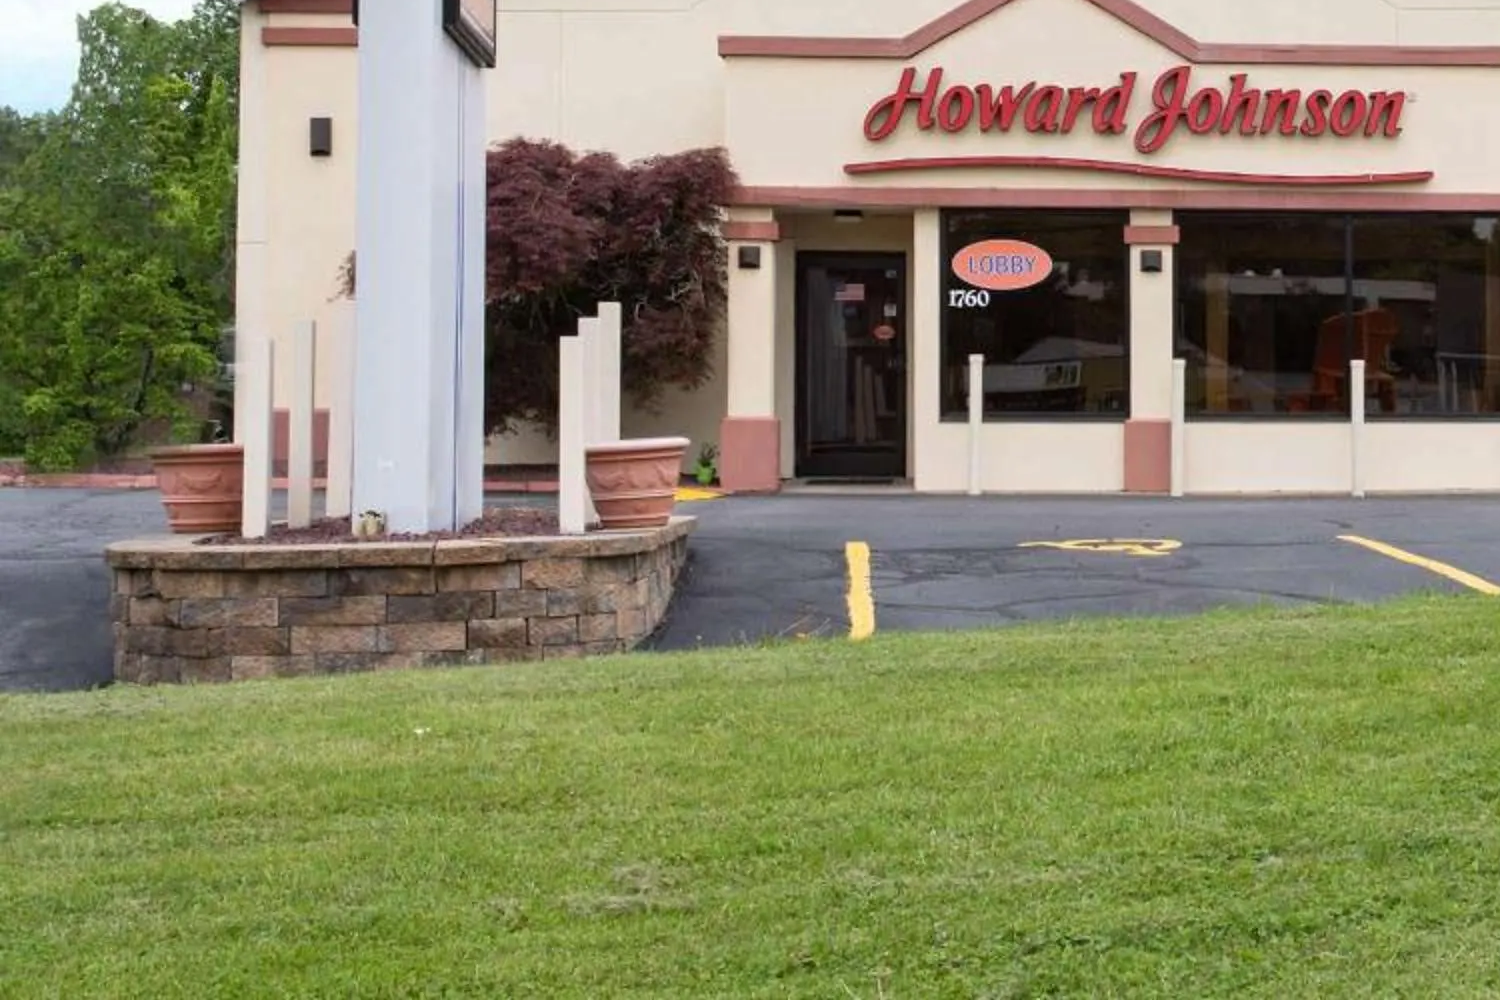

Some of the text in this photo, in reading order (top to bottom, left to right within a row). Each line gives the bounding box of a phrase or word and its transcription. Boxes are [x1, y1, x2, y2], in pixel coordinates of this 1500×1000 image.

[863, 65, 1406, 154] Howard Johnson
[968, 255, 1036, 274] LOBBY
[948, 289, 990, 308] 1760
